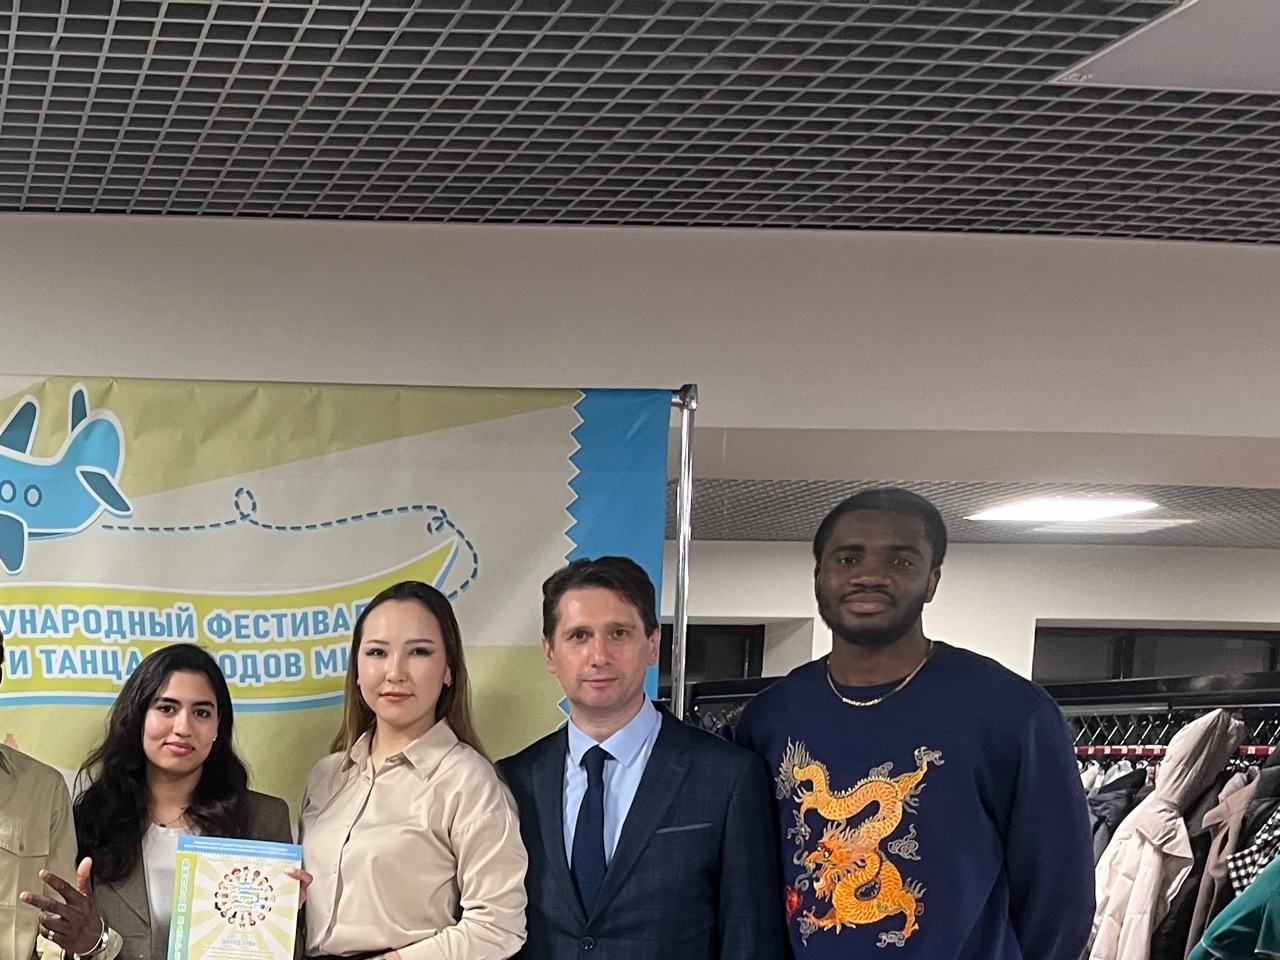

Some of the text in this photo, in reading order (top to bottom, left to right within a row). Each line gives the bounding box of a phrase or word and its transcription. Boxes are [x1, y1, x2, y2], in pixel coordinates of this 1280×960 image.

[207, 604, 368, 639] ФЕСТИВА
[9, 649, 28, 675] И
[39, 649, 141, 680] ТАНЦА
[218, 652, 302, 683] ОДОВ
